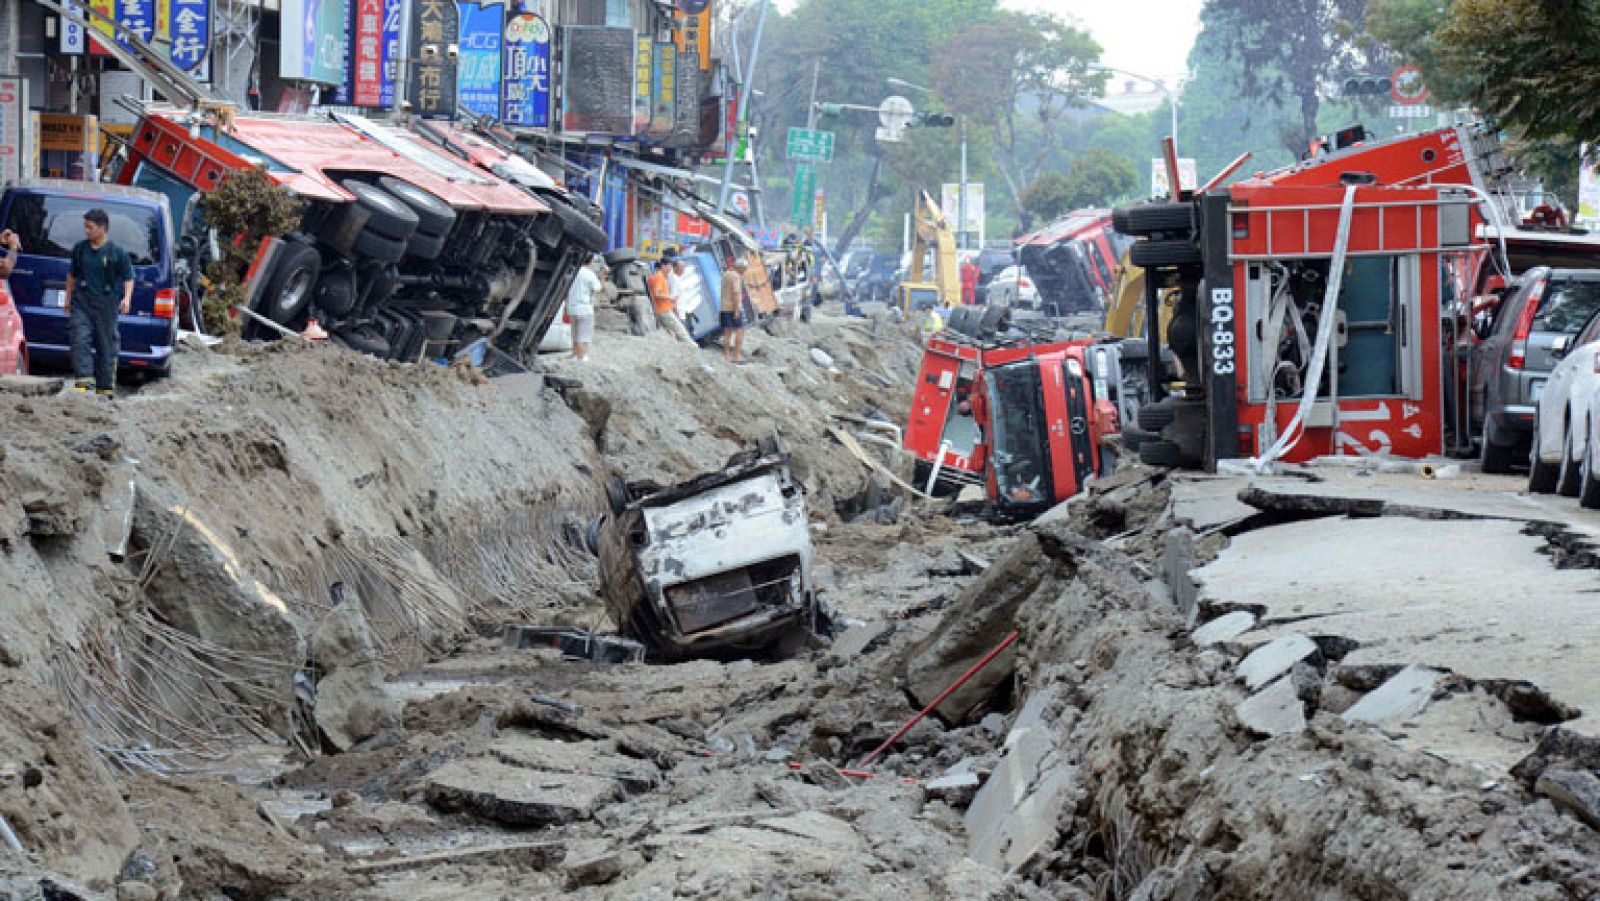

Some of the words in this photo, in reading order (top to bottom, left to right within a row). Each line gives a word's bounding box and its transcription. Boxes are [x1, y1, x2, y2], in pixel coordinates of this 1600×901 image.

[172, 0, 206, 62] 金行
[1210, 287, 1234, 374] BQ-833
[1335, 400, 1392, 457] 12
